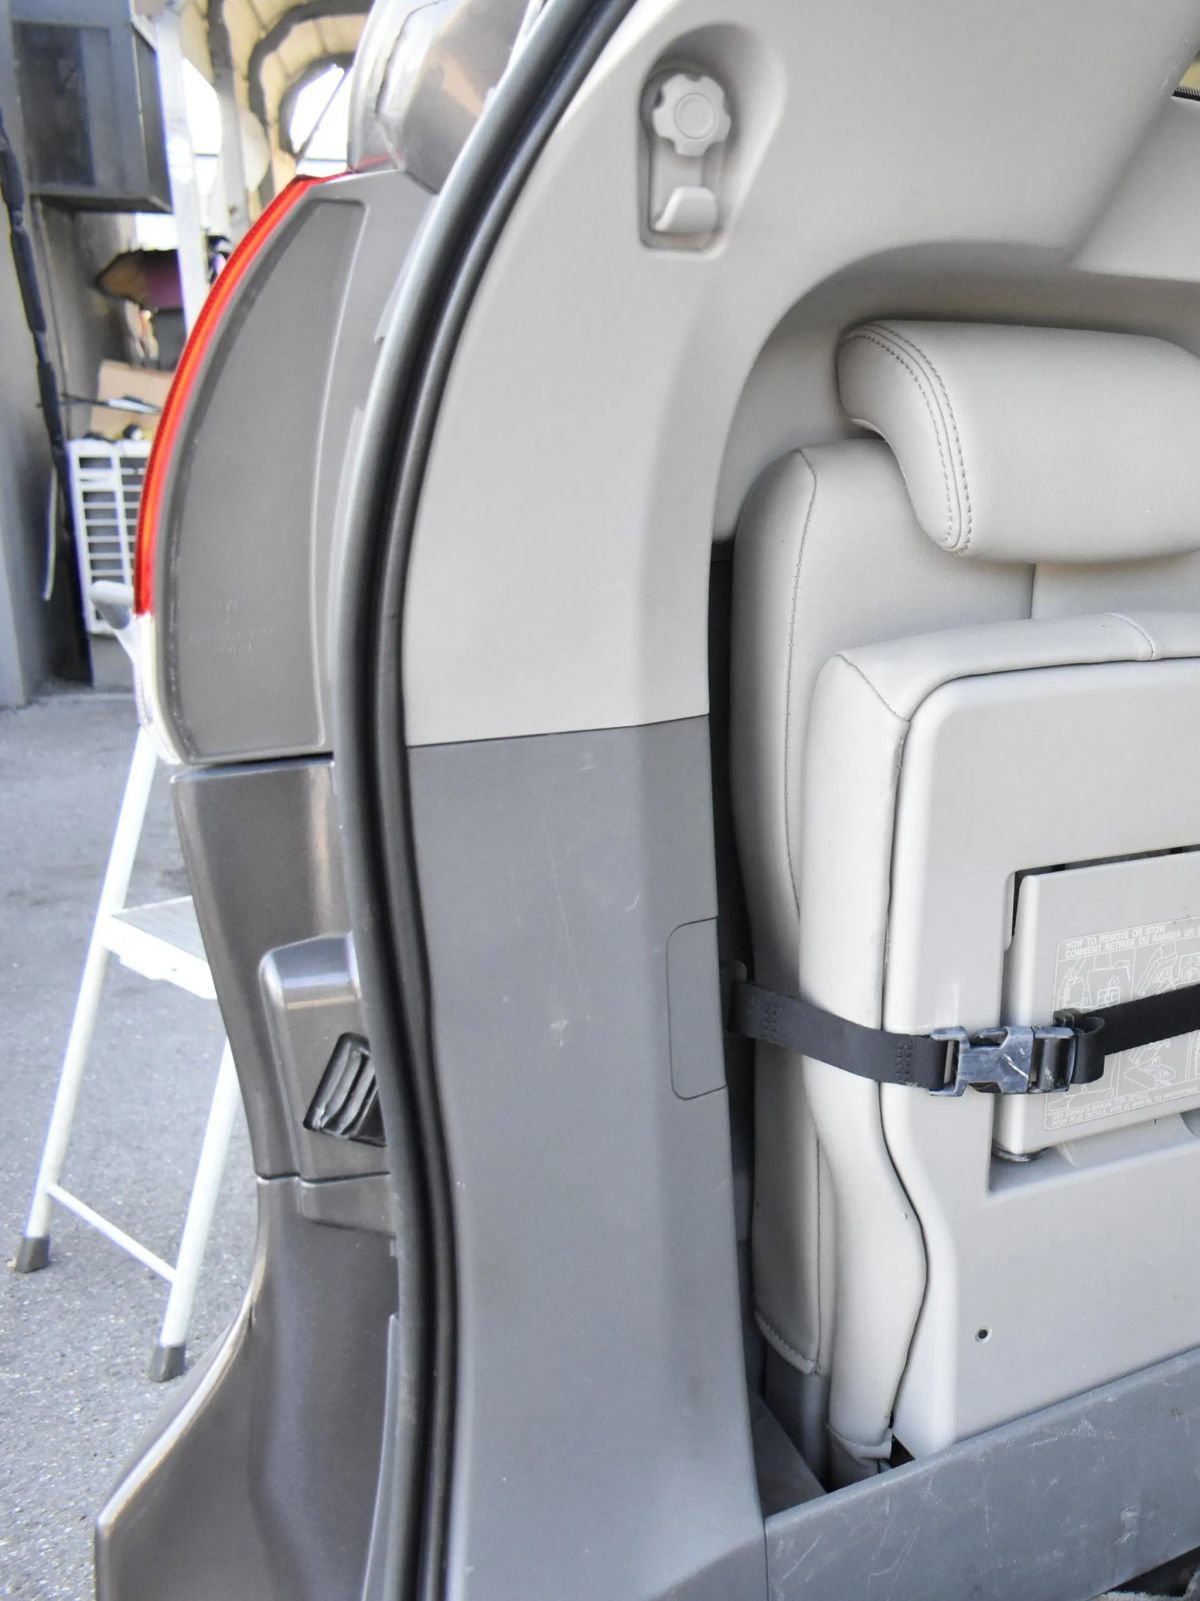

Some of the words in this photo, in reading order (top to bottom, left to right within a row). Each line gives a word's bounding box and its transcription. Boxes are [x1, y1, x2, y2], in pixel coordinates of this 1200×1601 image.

[1065, 939, 1084, 950] HOW
[1087, 937, 1097, 946] TO
[1100, 931, 1129, 943] REMOVE
[1132, 928, 1143, 938] OR
[1065, 945, 1101, 959] COMMENT
